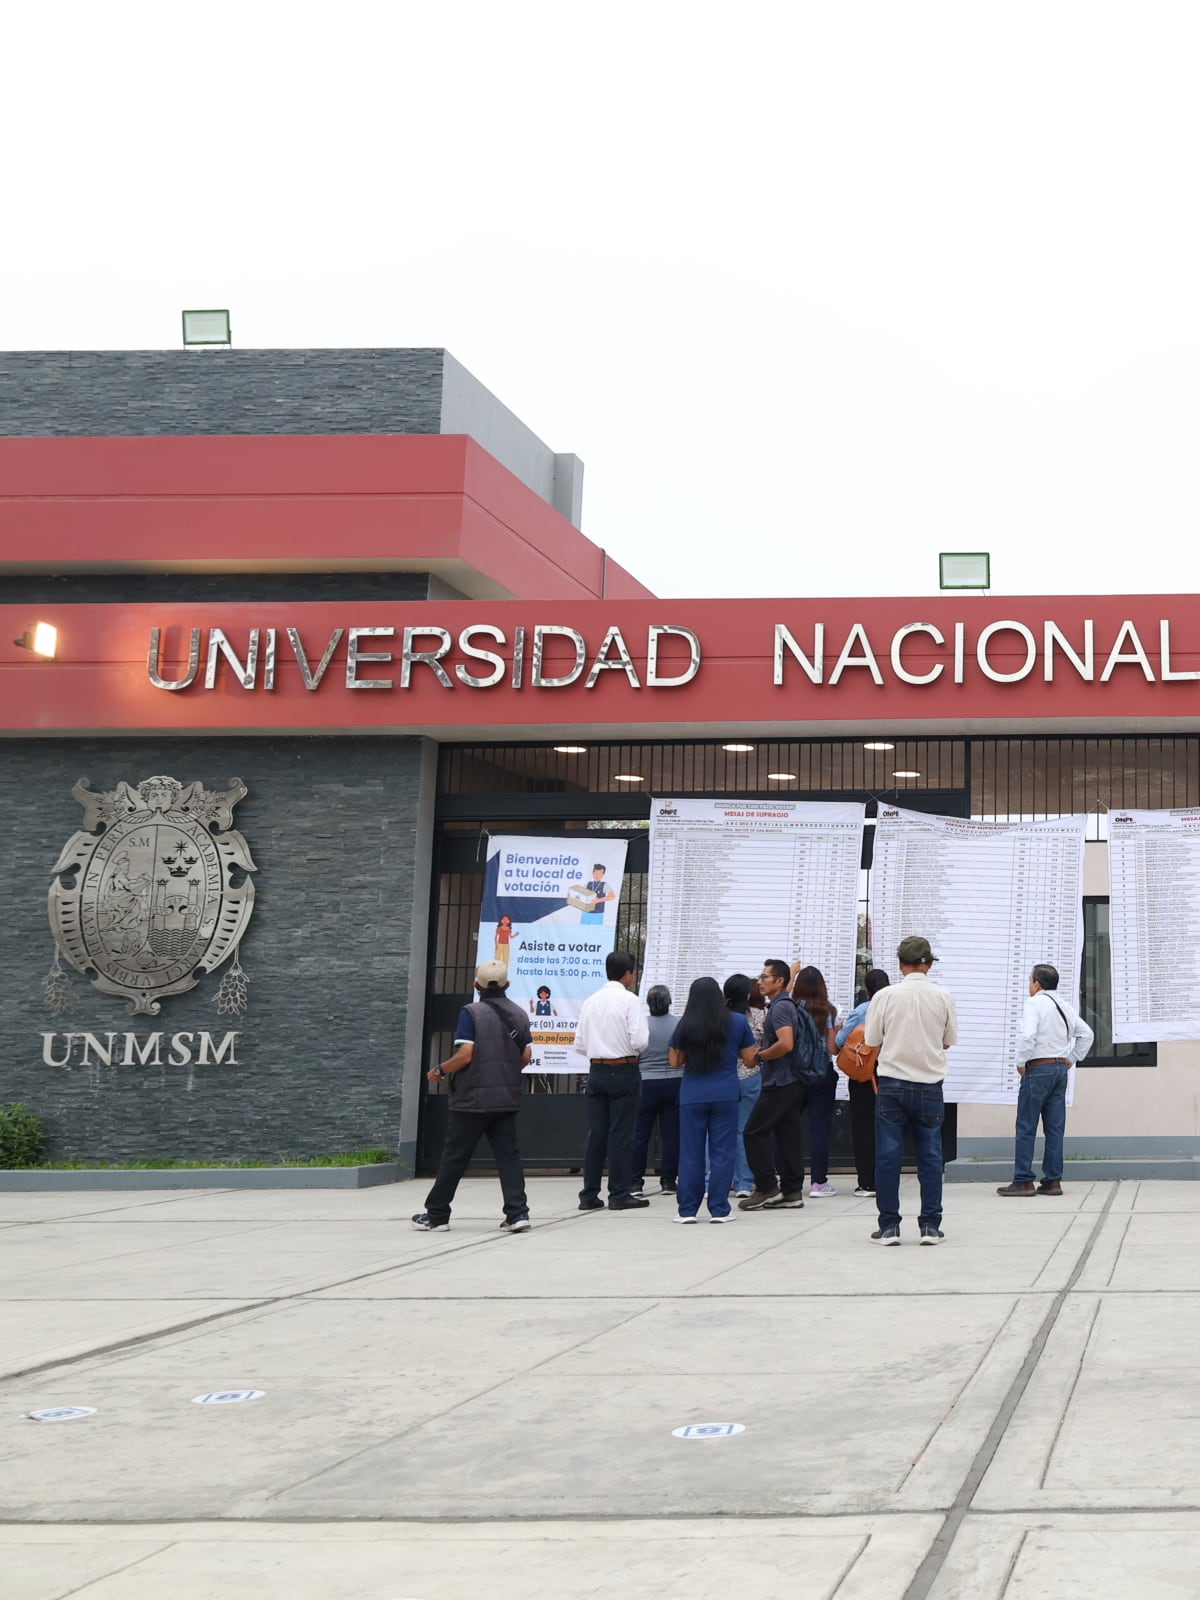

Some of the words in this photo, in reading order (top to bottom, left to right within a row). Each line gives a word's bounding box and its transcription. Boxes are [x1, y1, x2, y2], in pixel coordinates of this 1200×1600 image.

[146, 624, 700, 691] UNIVERSIDAD
[773, 619, 1200, 686] NACIONAL
[187, 826, 219, 904] ACADEMIA
[506, 853, 579, 866] Bienvenido
[505, 869, 512, 877] a
[516, 868, 528, 878] tu
[532, 868, 563, 879] local
[566, 869, 583, 879] de
[87, 872, 100, 888] IN
[505, 881, 559, 892] votación
[84, 901, 100, 957] REGVM
[519, 940, 555, 951] Asiste
[558, 943, 565, 951] a
[568, 942, 602, 952] votar
[517, 956, 545, 964] desde
[546, 956, 560, 964] las
[560, 968, 579, 976] 5:00
[581, 970, 590, 979] p.
[540, 1020, 554, 1029] (01)
[531, 1034, 575, 1043] ob.pe/onp
[40, 1031, 240, 1067] UNMSM
